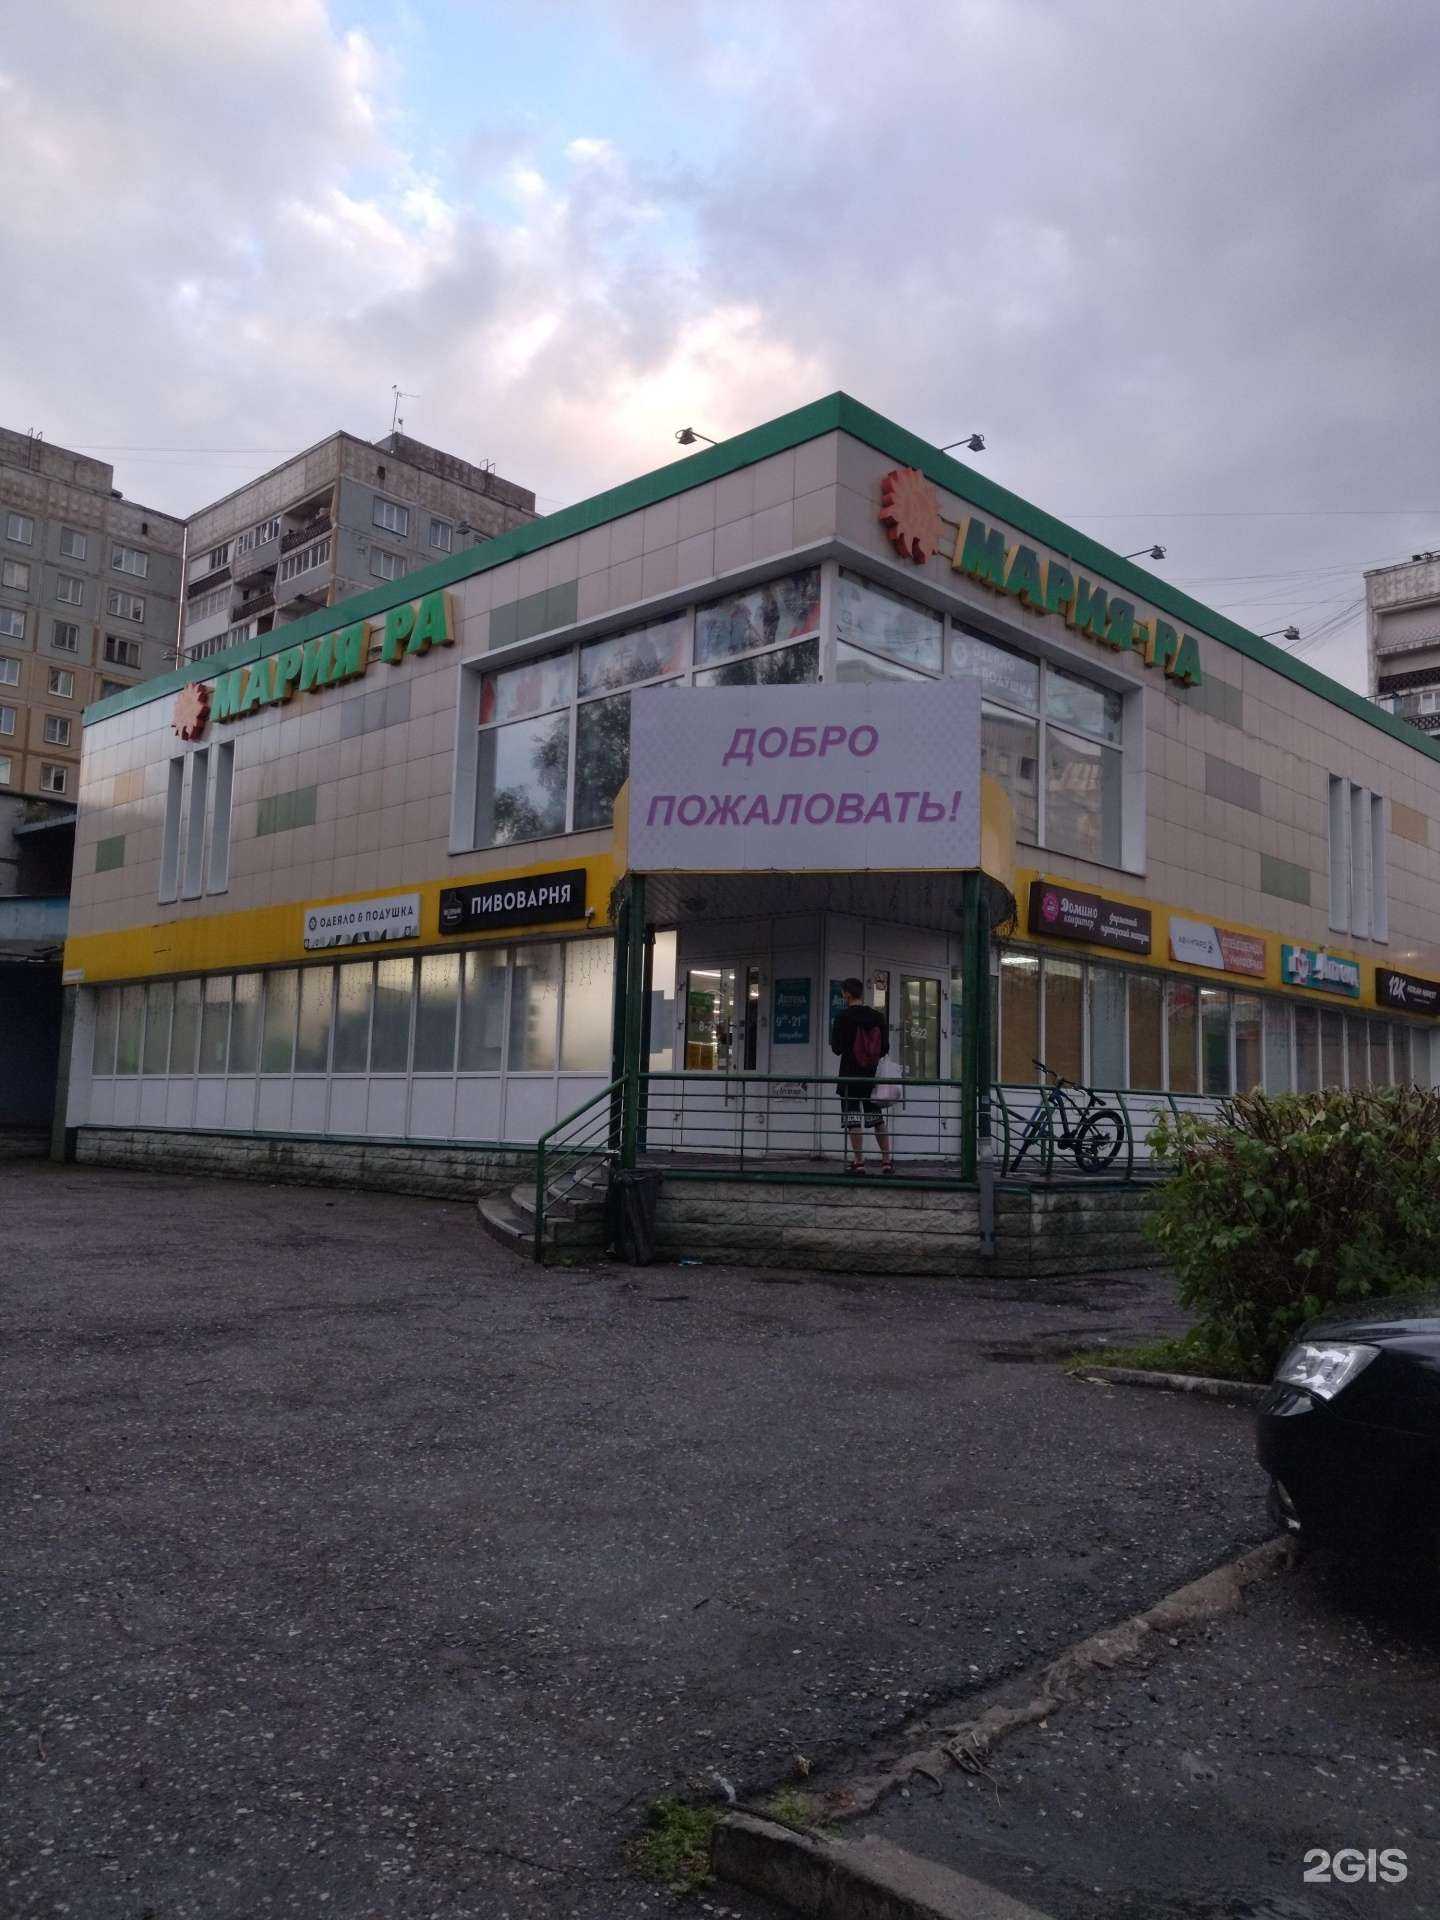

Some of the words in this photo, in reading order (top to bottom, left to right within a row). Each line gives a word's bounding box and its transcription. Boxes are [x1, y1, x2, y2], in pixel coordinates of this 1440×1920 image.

[210, 622, 370, 723] МАРИЯ
[381, 590, 452, 664] РА
[721, 725, 879, 767] ДОБРО
[646, 791, 963, 827] ПОЖАЛОВАТЬ!
[319, 913, 356, 929] ОДЕЯЛО
[365, 905, 414, 921] ПОДУШКА
[471, 884, 571, 915] ПИВОВАРНЯ
